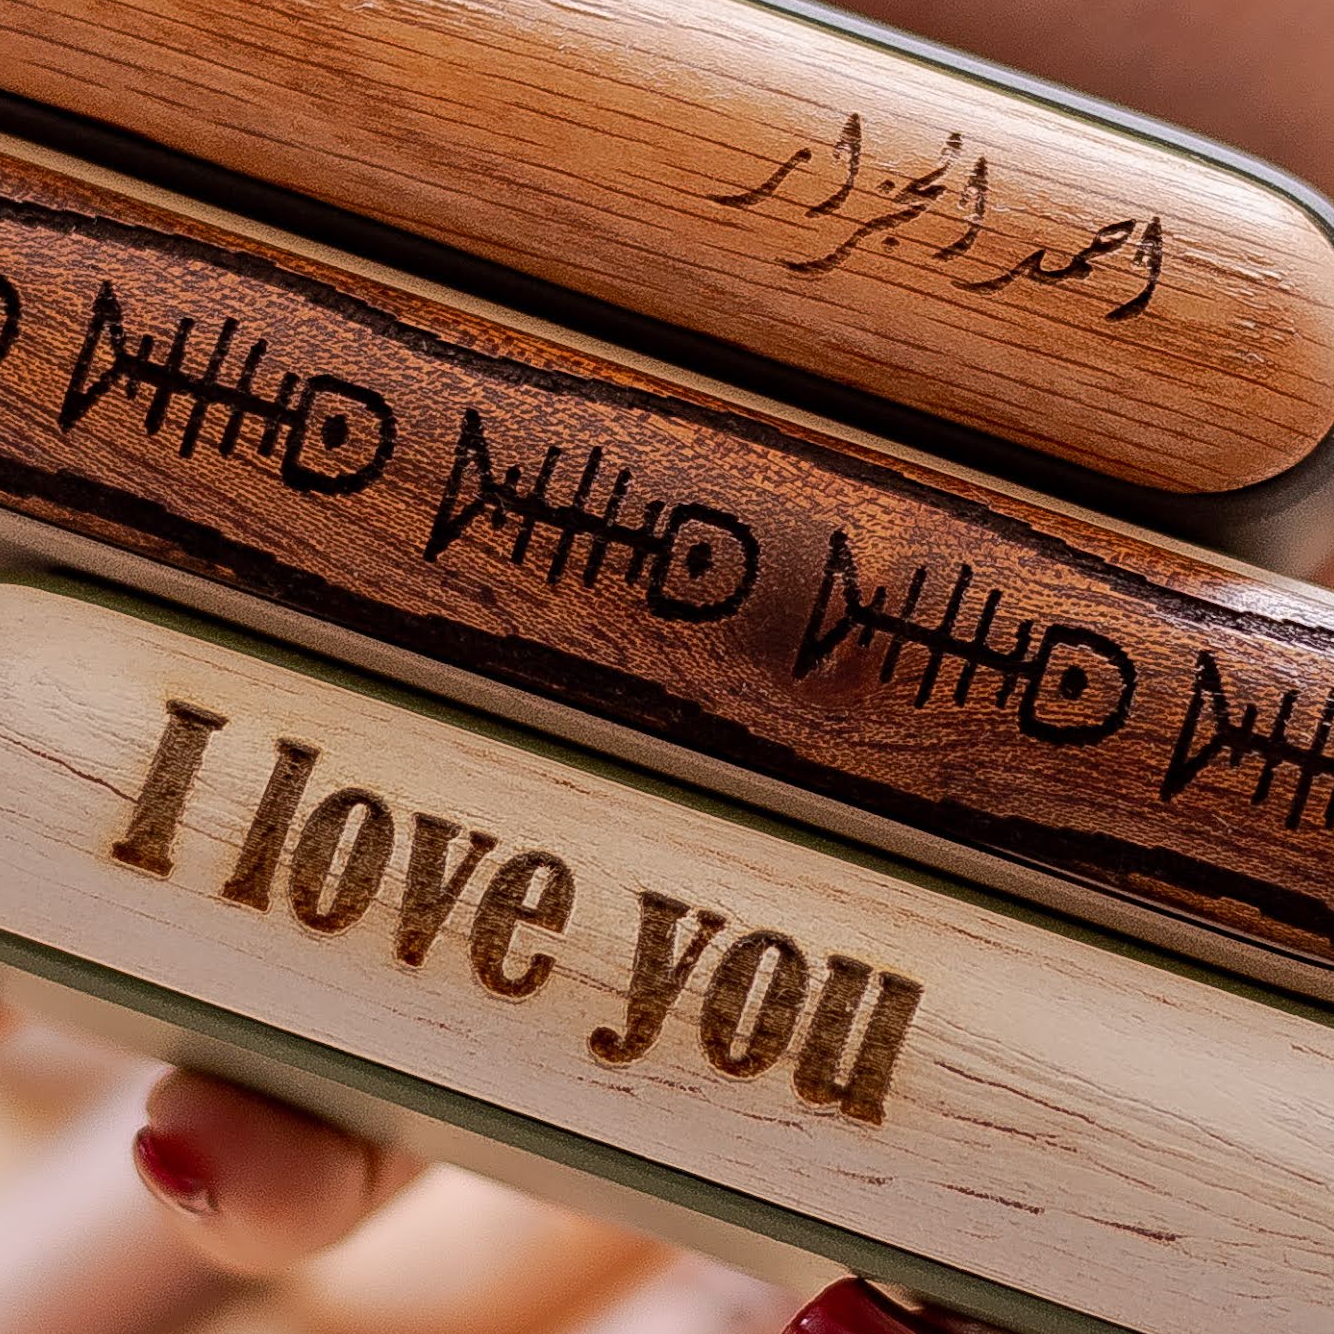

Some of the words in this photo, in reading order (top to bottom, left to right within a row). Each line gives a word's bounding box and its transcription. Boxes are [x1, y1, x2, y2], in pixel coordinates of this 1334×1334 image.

[112, 699, 228, 878] I
[221, 736, 576, 1001] love
[587, 889, 924, 1127] you
